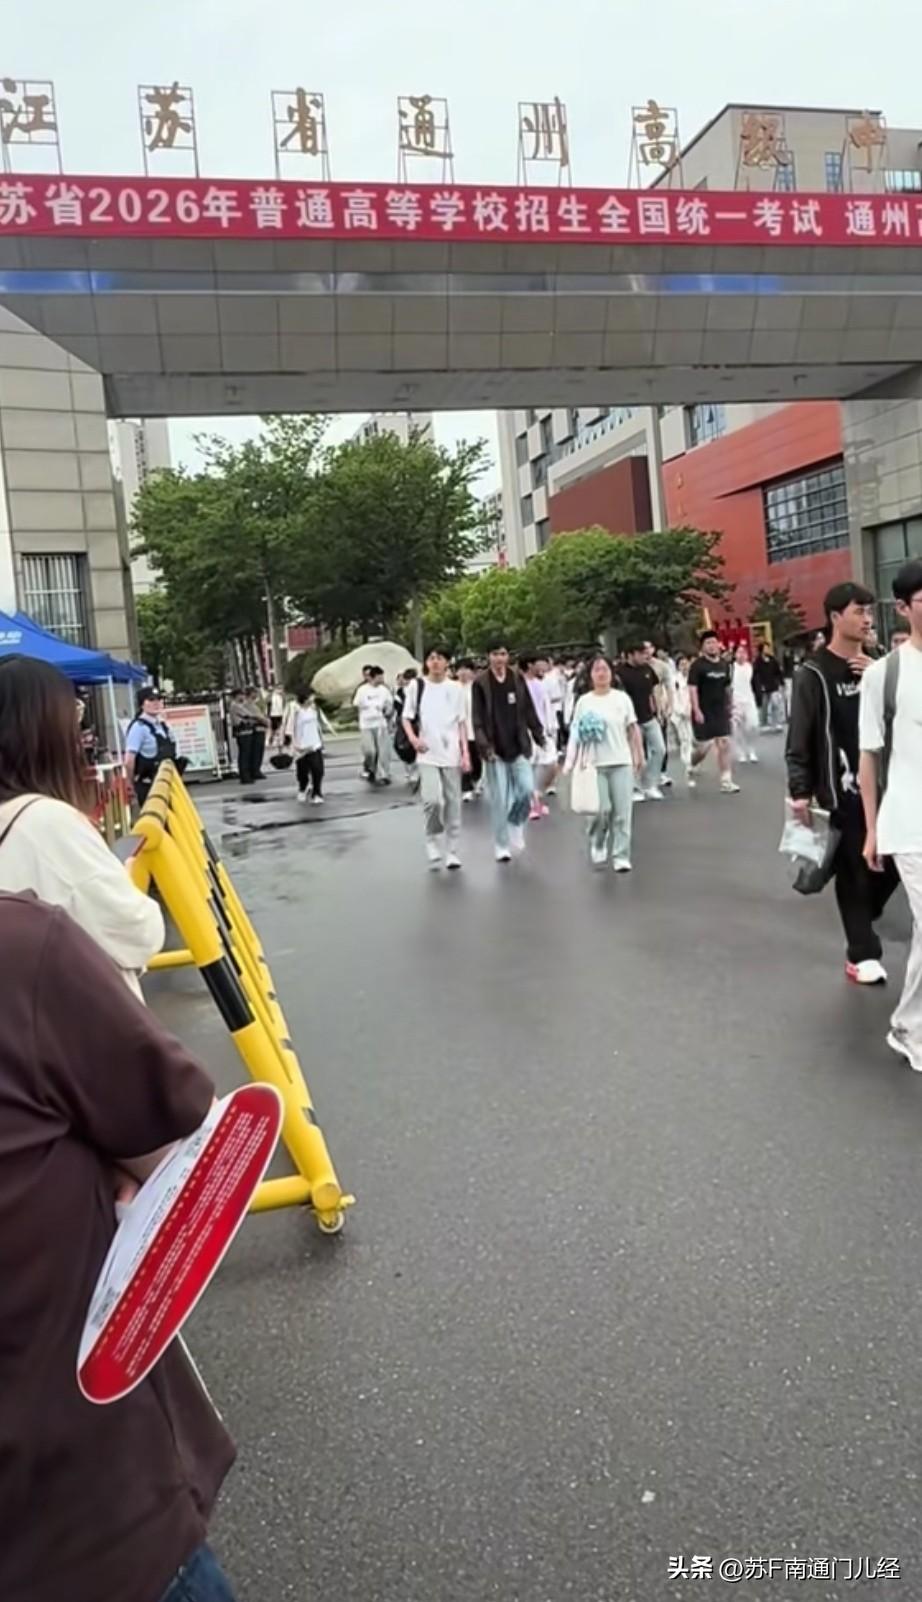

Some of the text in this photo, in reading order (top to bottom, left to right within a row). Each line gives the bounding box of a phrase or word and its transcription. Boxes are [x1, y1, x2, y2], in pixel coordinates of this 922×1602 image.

[0, 181, 922, 237] 苏省2026年普通高等学校招生全国统一考试 通州
